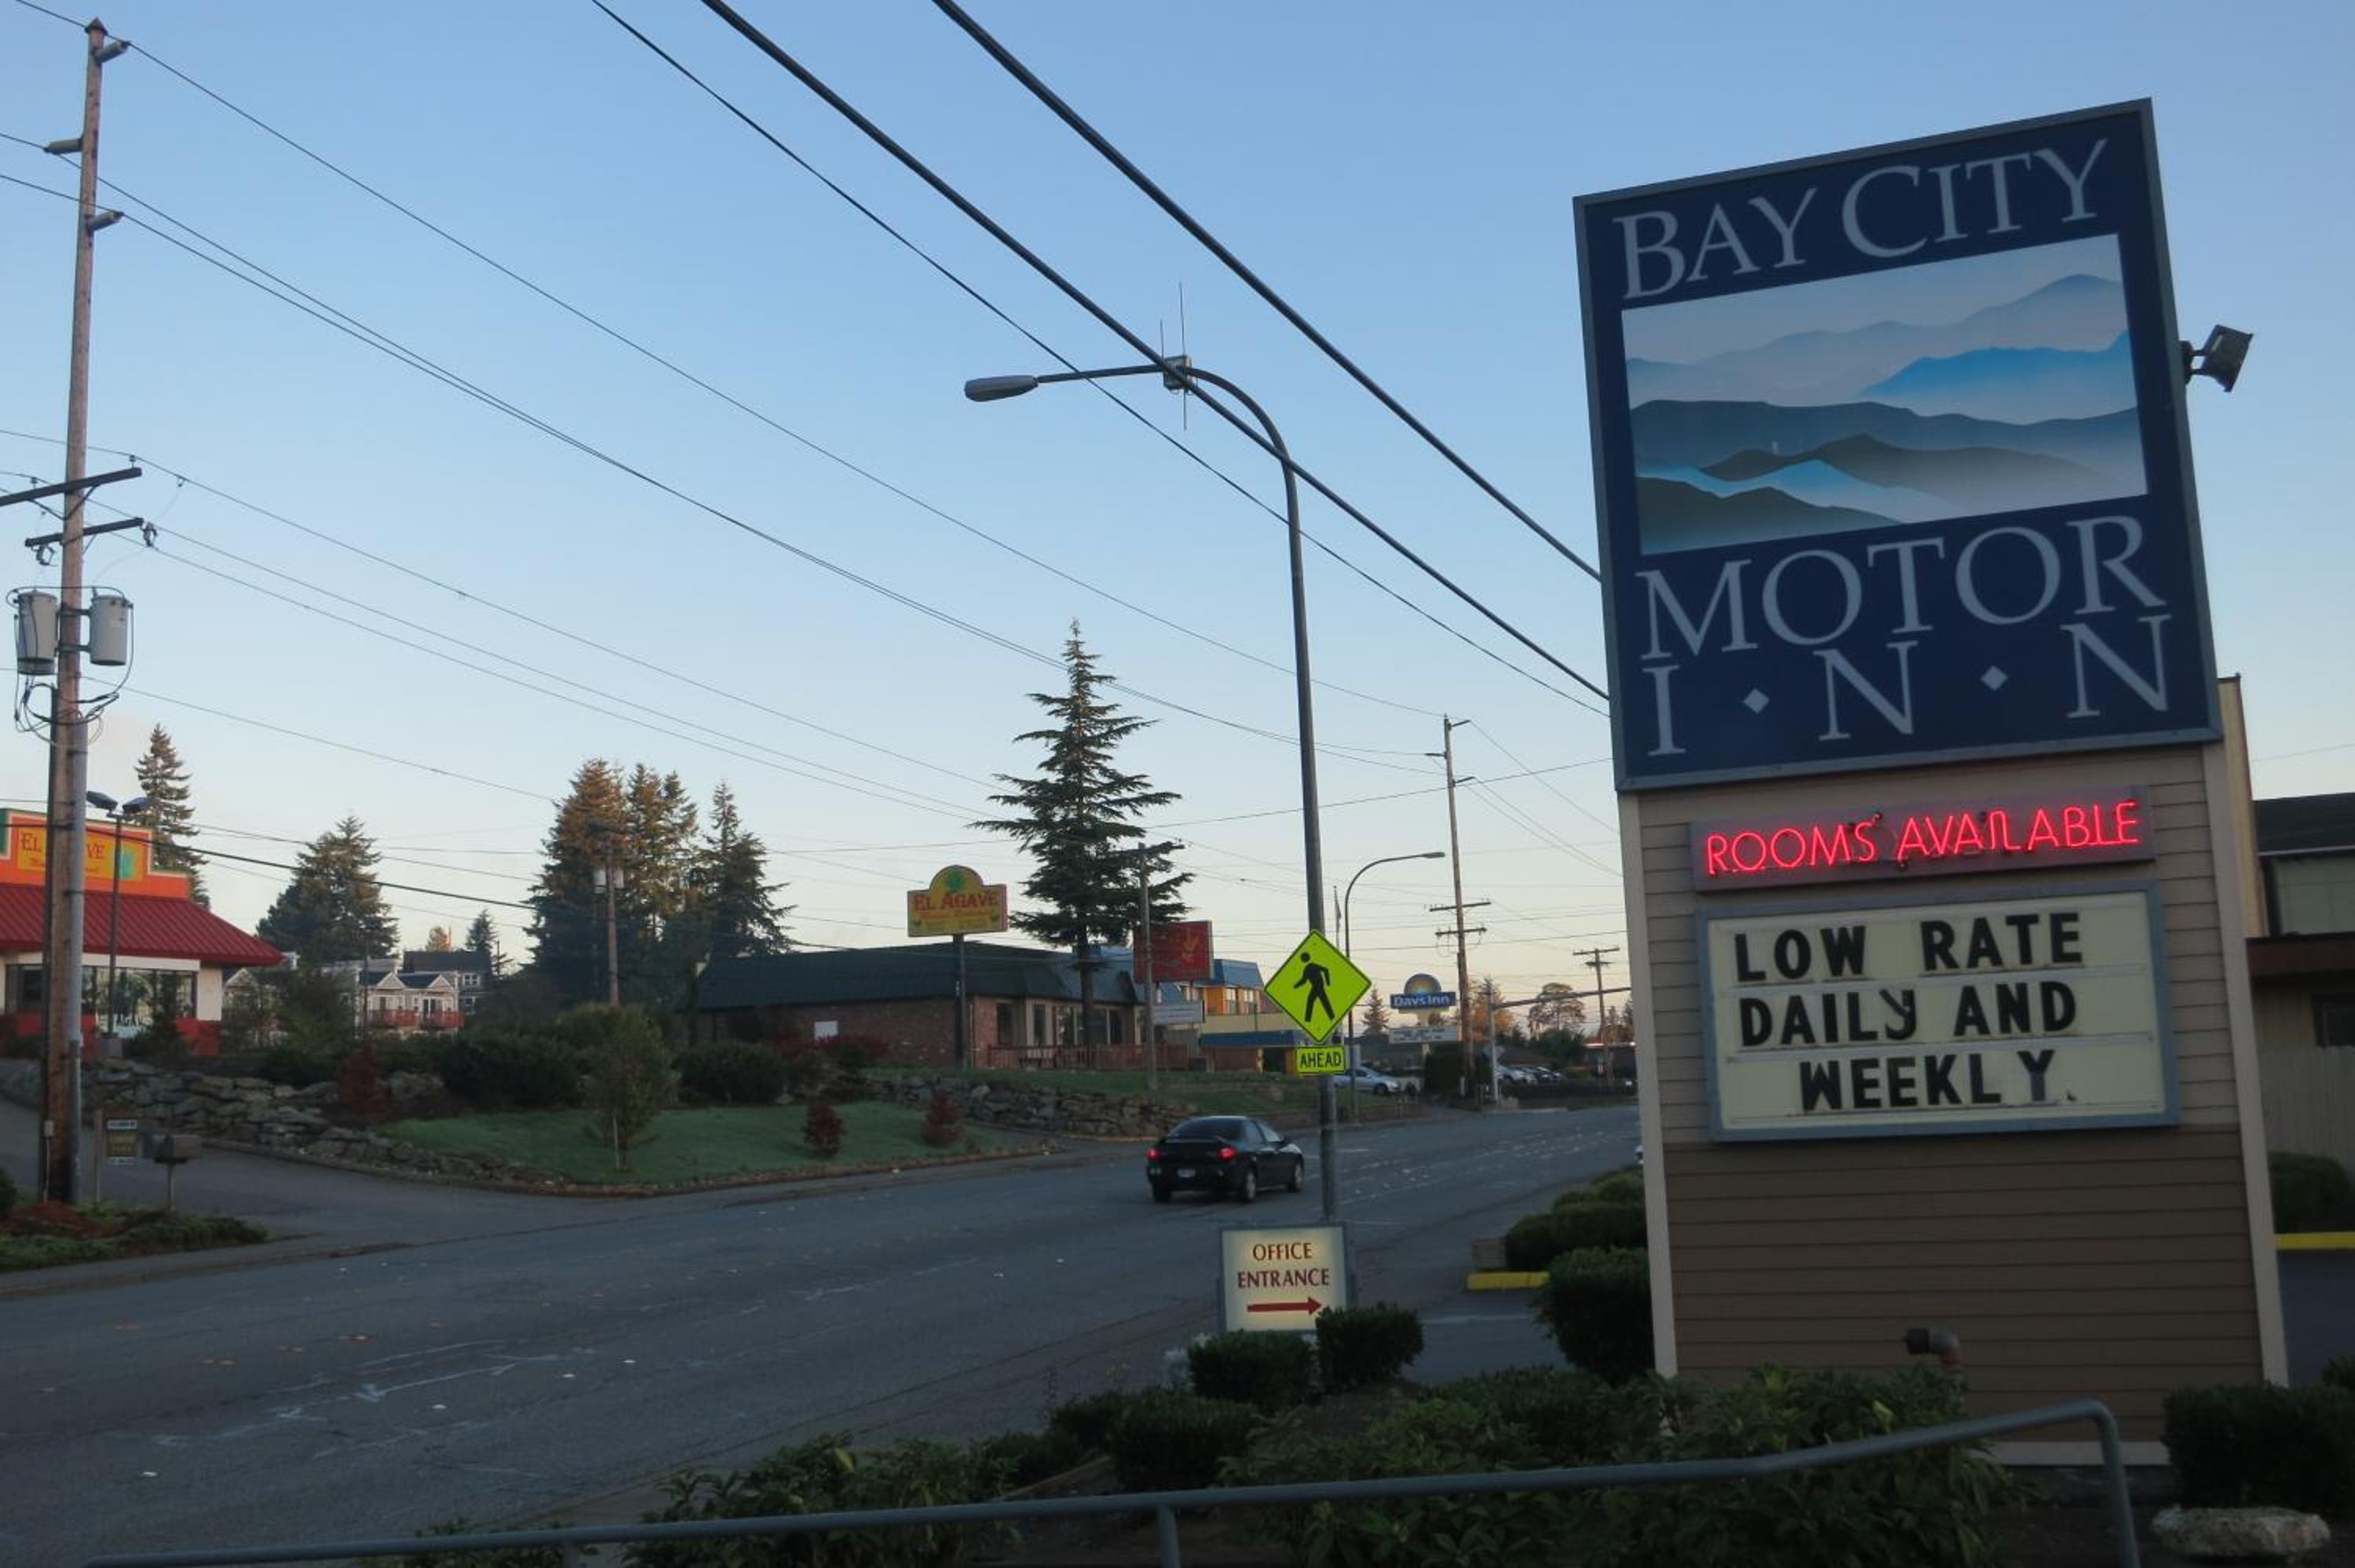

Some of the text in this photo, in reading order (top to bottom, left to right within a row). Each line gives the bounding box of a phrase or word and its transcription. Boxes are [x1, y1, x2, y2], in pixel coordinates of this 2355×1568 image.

[1613, 139, 2110, 300] BAY CITY
[1636, 515, 2167, 662] MOTOR
[1707, 800, 2139, 876] ROOMS AVAILABLE
[1734, 912, 2083, 983] LOW RATE
[1394, 994, 1450, 1006] Days Inn
[1953, 981, 2077, 1037] AND
[1299, 1051, 1342, 1068] AHEAD
[1237, 1267, 1330, 1289] ENTRANCE
[1253, 1242, 1313, 1261] OFFICE
